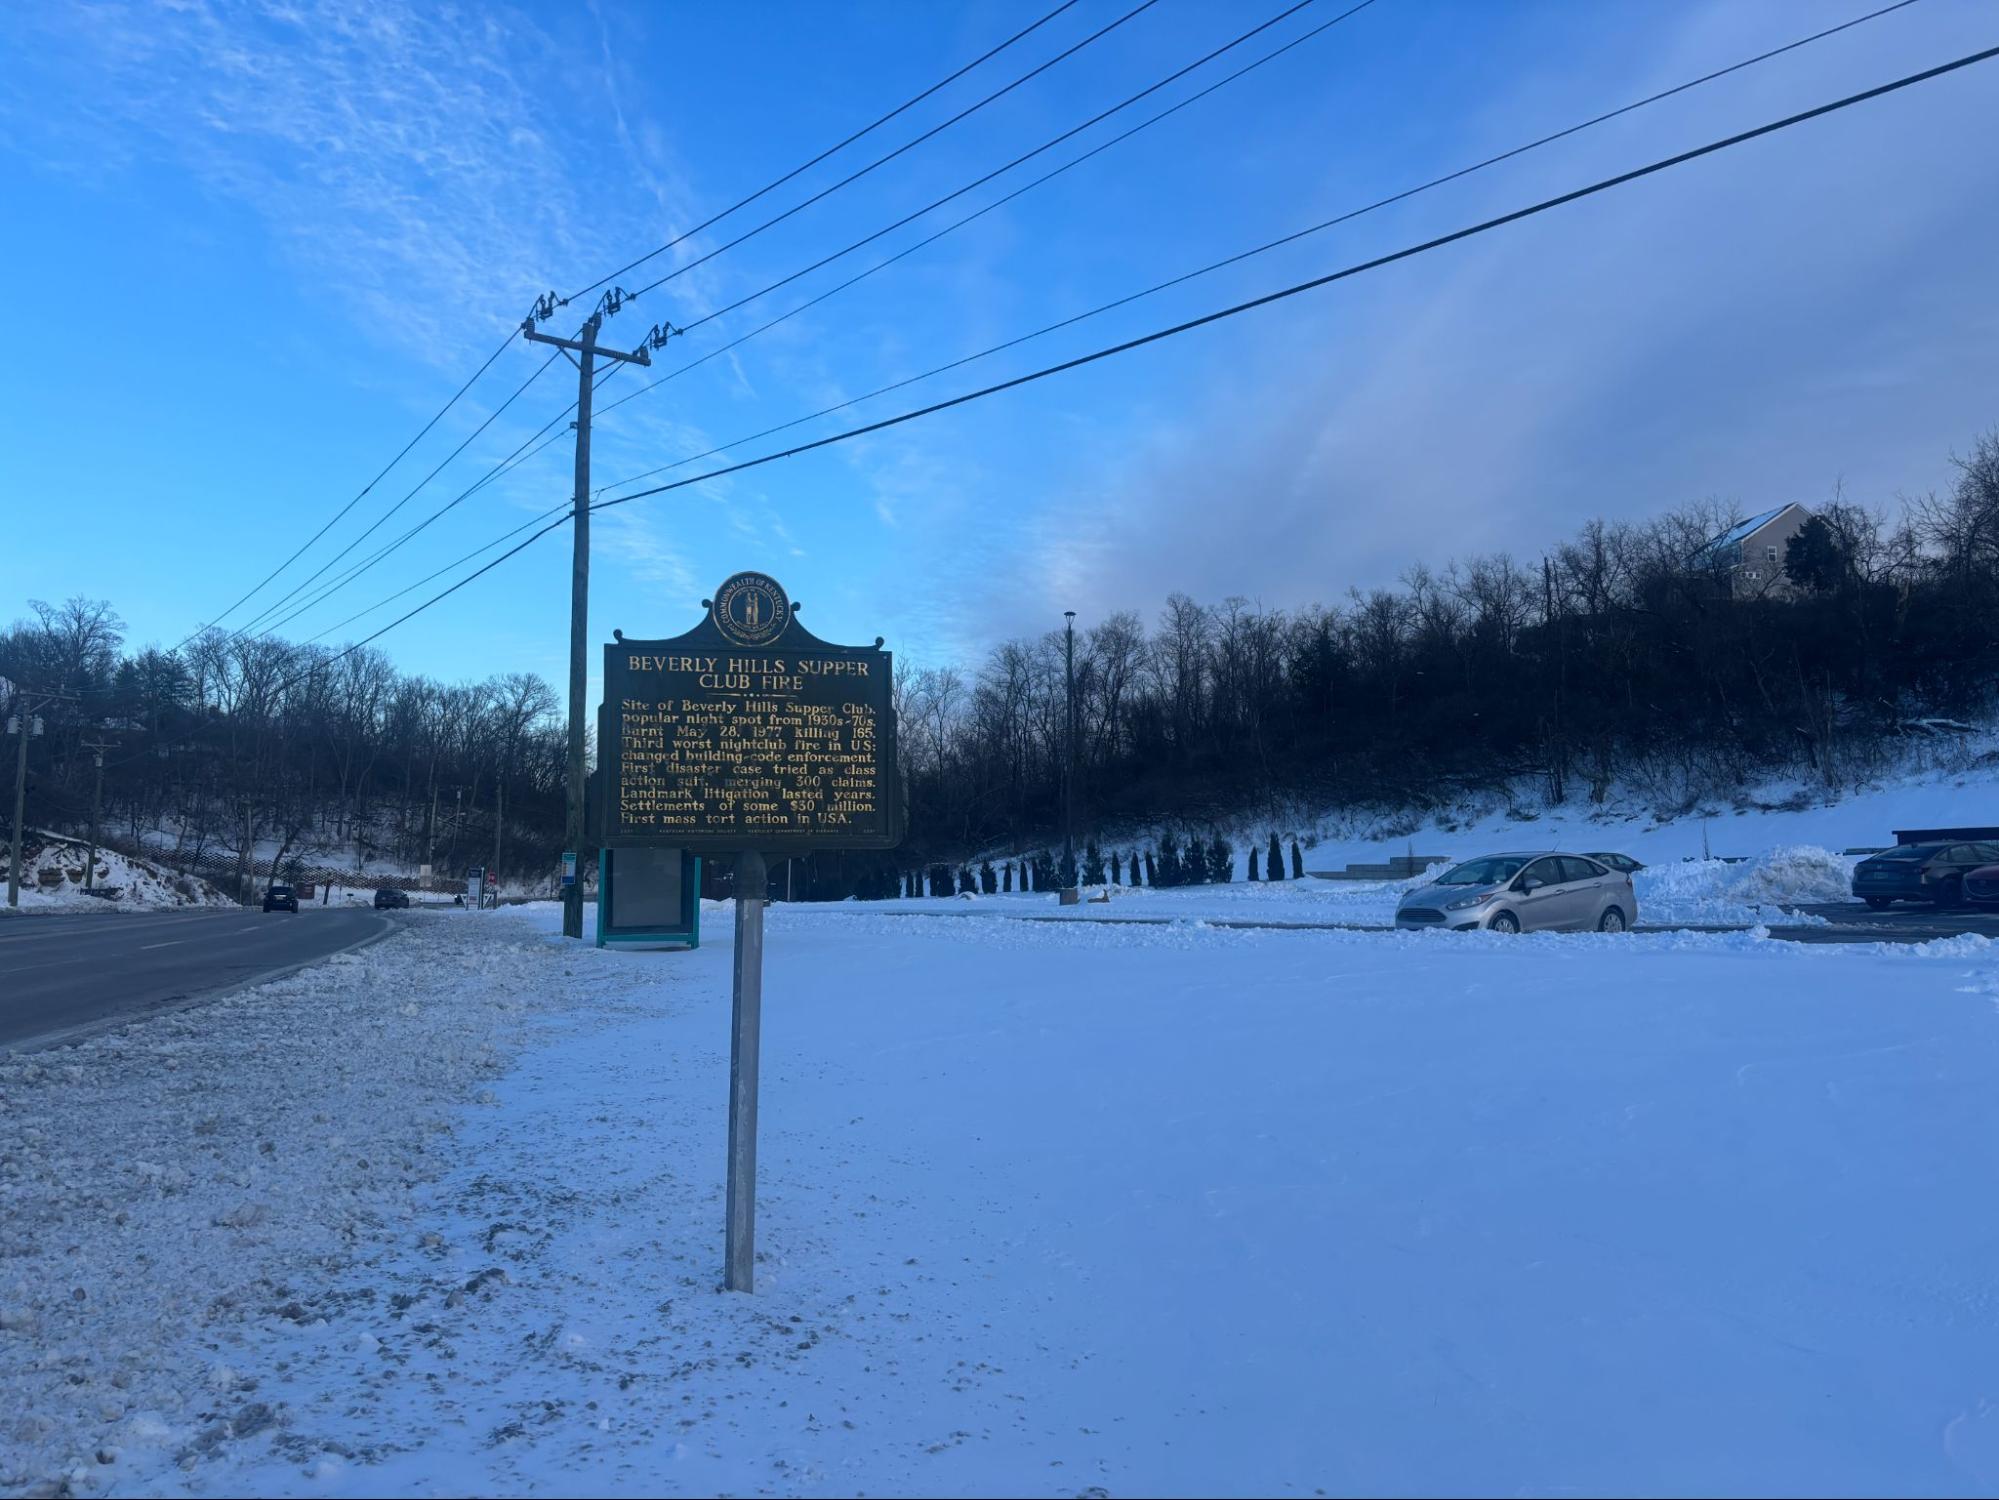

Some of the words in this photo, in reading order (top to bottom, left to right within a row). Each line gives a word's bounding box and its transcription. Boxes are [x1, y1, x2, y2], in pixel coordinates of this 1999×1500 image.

[628, 655, 718, 672] BEVERLY
[729, 658, 785, 674] HILLS
[797, 660, 869, 676] SUPPER
[699, 673, 750, 689] CLUB
[762, 675, 803, 690] FIRE
[621, 699, 649, 711] Site
[657, 699, 674, 711] of
[682, 699, 737, 714] Beverly
[745, 700, 778, 713] Hills
[785, 701, 834, 716] Supper
[622, 711, 679, 725] popular
[686, 712, 724, 727] night
[732, 713, 762, 727] spot
[769, 713, 802, 725] from
[621, 724, 664, 737] Burnt
[677, 725, 707, 738] May
[753, 726, 782, 738] 1977
[795, 726, 840, 740] killing
[852, 727, 876, 739] 165.
[621, 736, 663, 749] Third
[673, 738, 712, 749] worst
[720, 737, 787, 752] nightclub
[795, 738, 821, 751] fire
[828, 739, 842, 751] in
[621, 750, 679, 763] changed
[686, 750, 782, 764] building-code
[787, 751, 876, 764] enforcement.
[621, 761, 656, 774] First
[666, 762, 721, 774] disaster
[732, 764, 762, 775] case
[773, 763, 808, 775] tried
[818, 765, 834, 775] as
[844, 764, 876, 775] class
[621, 775, 665, 787] action
[725, 776, 782, 789] merging
[795, 775, 821, 788] 300
[831, 776, 876, 788] claims.
[620, 786, 693, 799] Landmark
[704, 787, 769, 801] litigation
[782, 788, 824, 800] lasted
[833, 789, 876, 801] years.
[620, 799, 705, 811] Settlements
[719, 799, 736, 811] of
[743, 801, 778, 811] some
[790, 799, 815, 812] $30
[827, 800, 876, 812] million.
[621, 811, 656, 824] First
[663, 814, 696, 824] mass
[706, 812, 736, 824] tort
[745, 812, 788, 824] action
[797, 812, 810, 824] in
[817, 812, 852, 824] USA.
